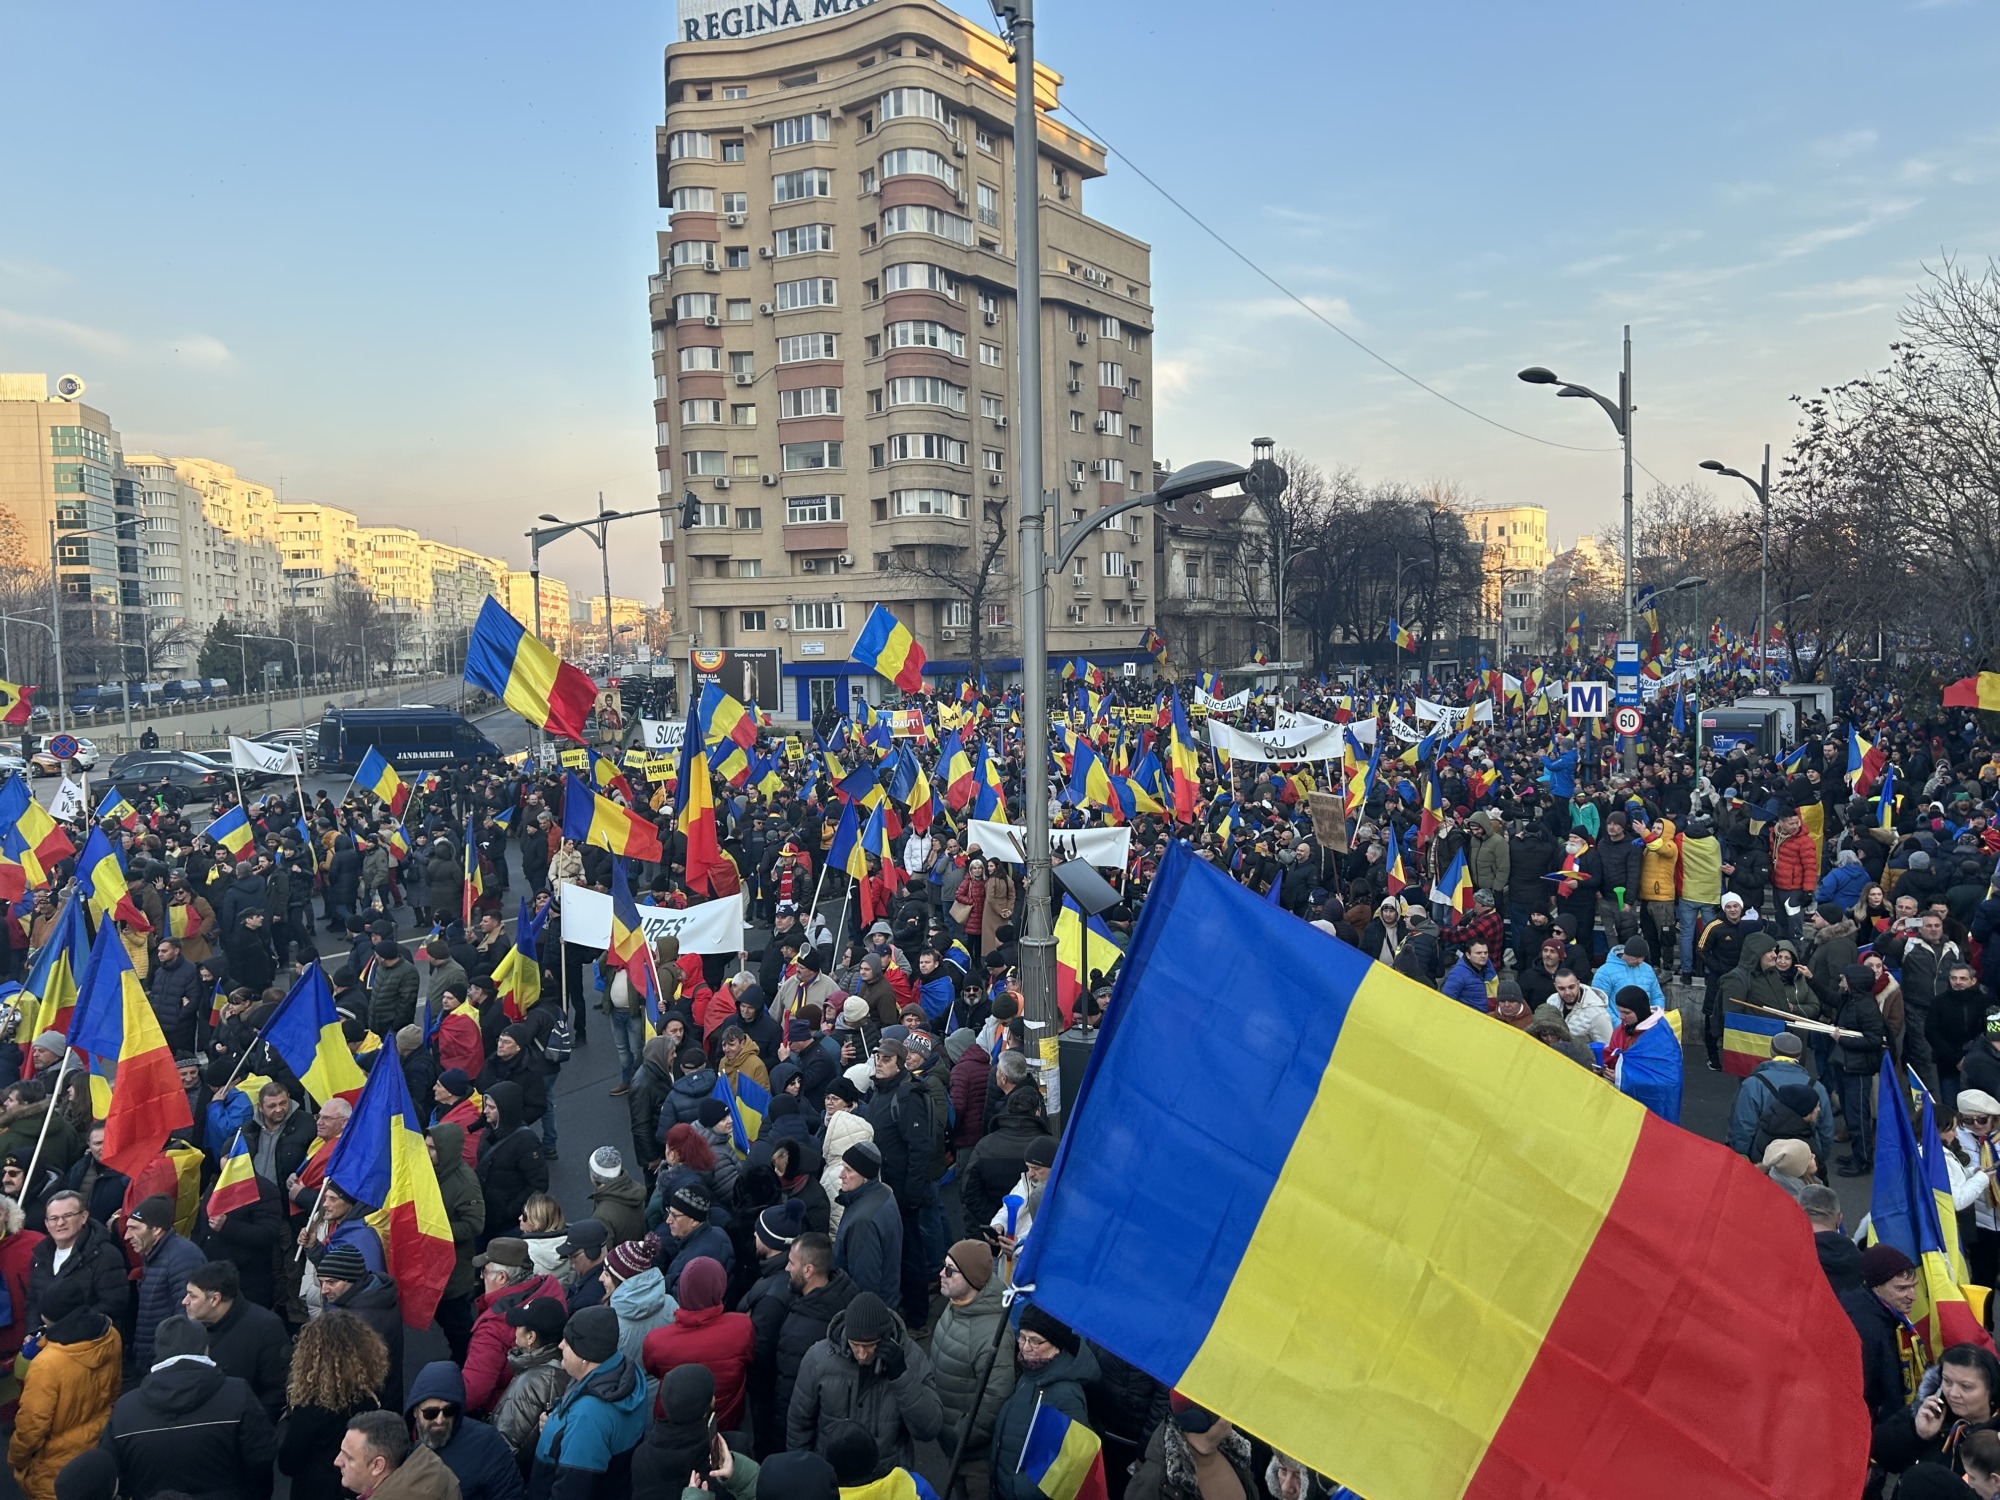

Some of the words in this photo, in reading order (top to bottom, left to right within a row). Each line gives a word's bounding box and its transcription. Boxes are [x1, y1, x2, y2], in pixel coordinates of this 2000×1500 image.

[684, 0, 803, 41] REGINA
[1126, 665, 1133, 674] M
[1203, 696, 1241, 710] SUCEAVA
[1572, 687, 1602, 712] M
[1620, 714, 1635, 728] 60
[396, 750, 454, 760] JANDARMERIA
[1263, 744, 1307, 759] CLUJ
[647, 763, 674, 776] ȘCHEIA
